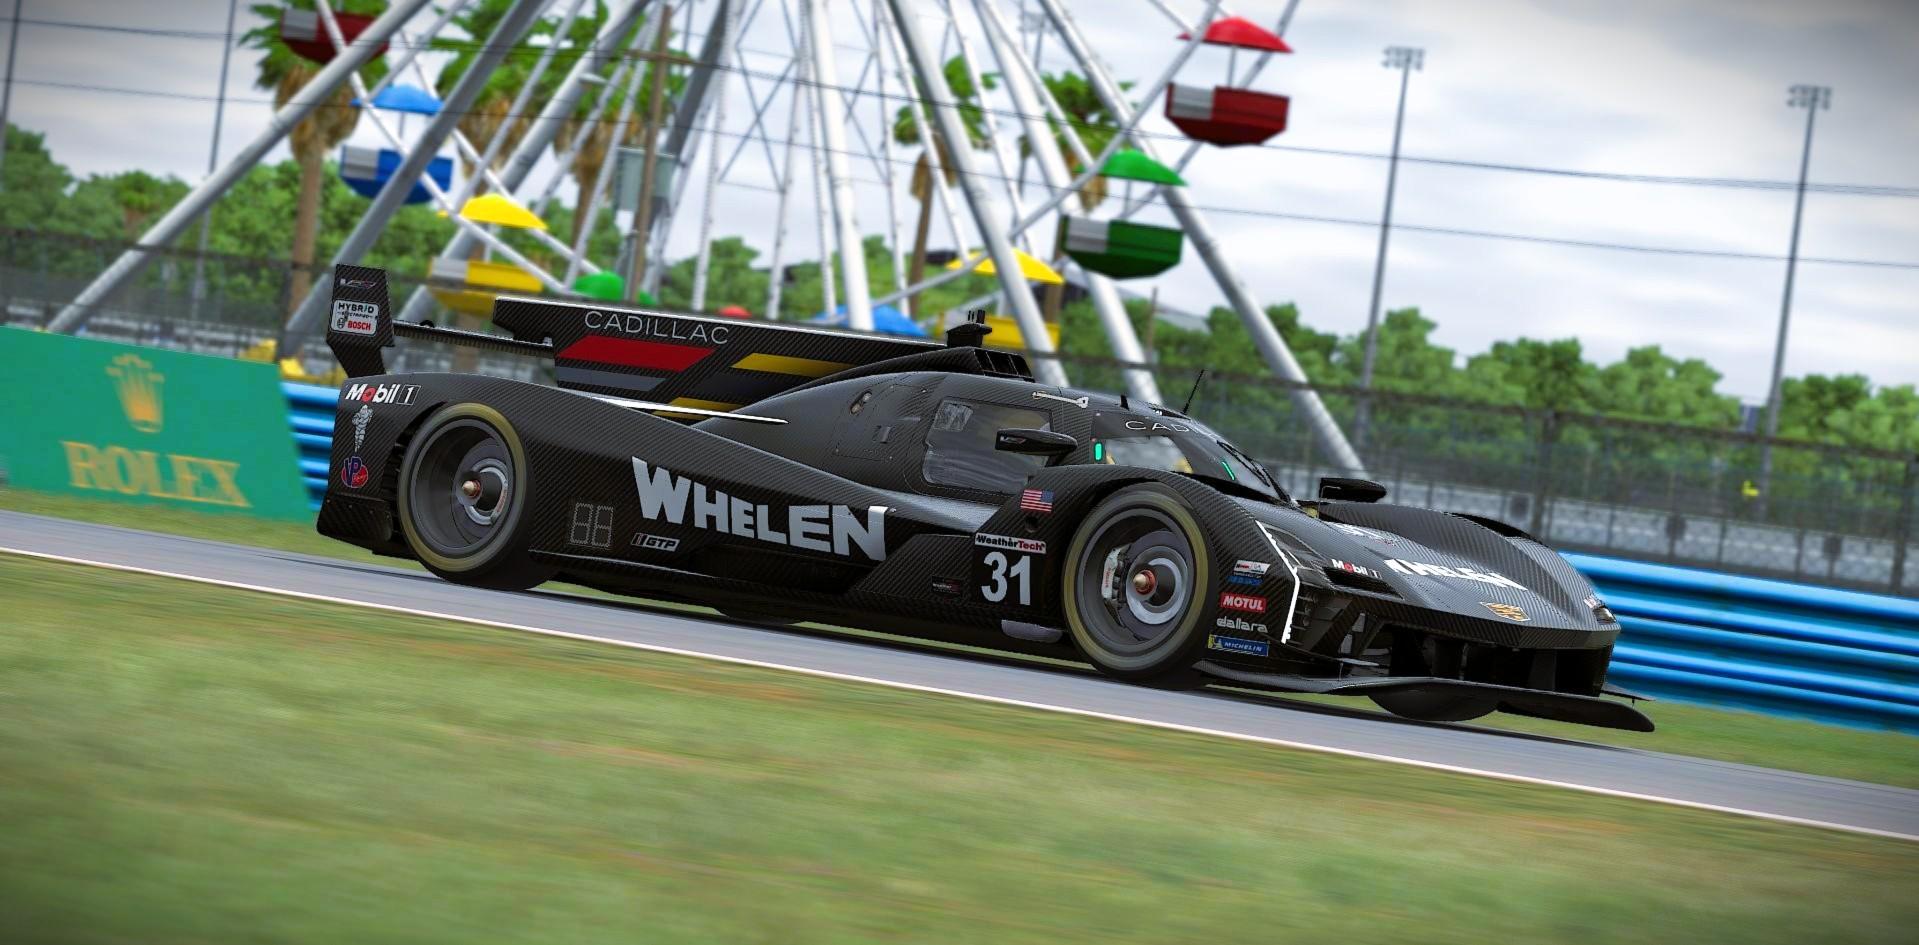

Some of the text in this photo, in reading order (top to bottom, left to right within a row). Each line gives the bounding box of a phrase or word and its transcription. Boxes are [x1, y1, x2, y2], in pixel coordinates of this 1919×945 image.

[338, 302, 374, 313] HYBRID
[347, 320, 371, 331] BOSCH
[584, 310, 730, 345] CADILLAC
[345, 384, 415, 405] Mobil 1
[61, 440, 252, 507] ROLEX
[631, 456, 888, 561] WHELEN
[1331, 558, 1369, 576] Mobil
[981, 551, 1031, 606] 31
[1222, 595, 1264, 611] MOTUL
[1216, 615, 1268, 633] dallara
[1224, 641, 1263, 652] MICHELIN
